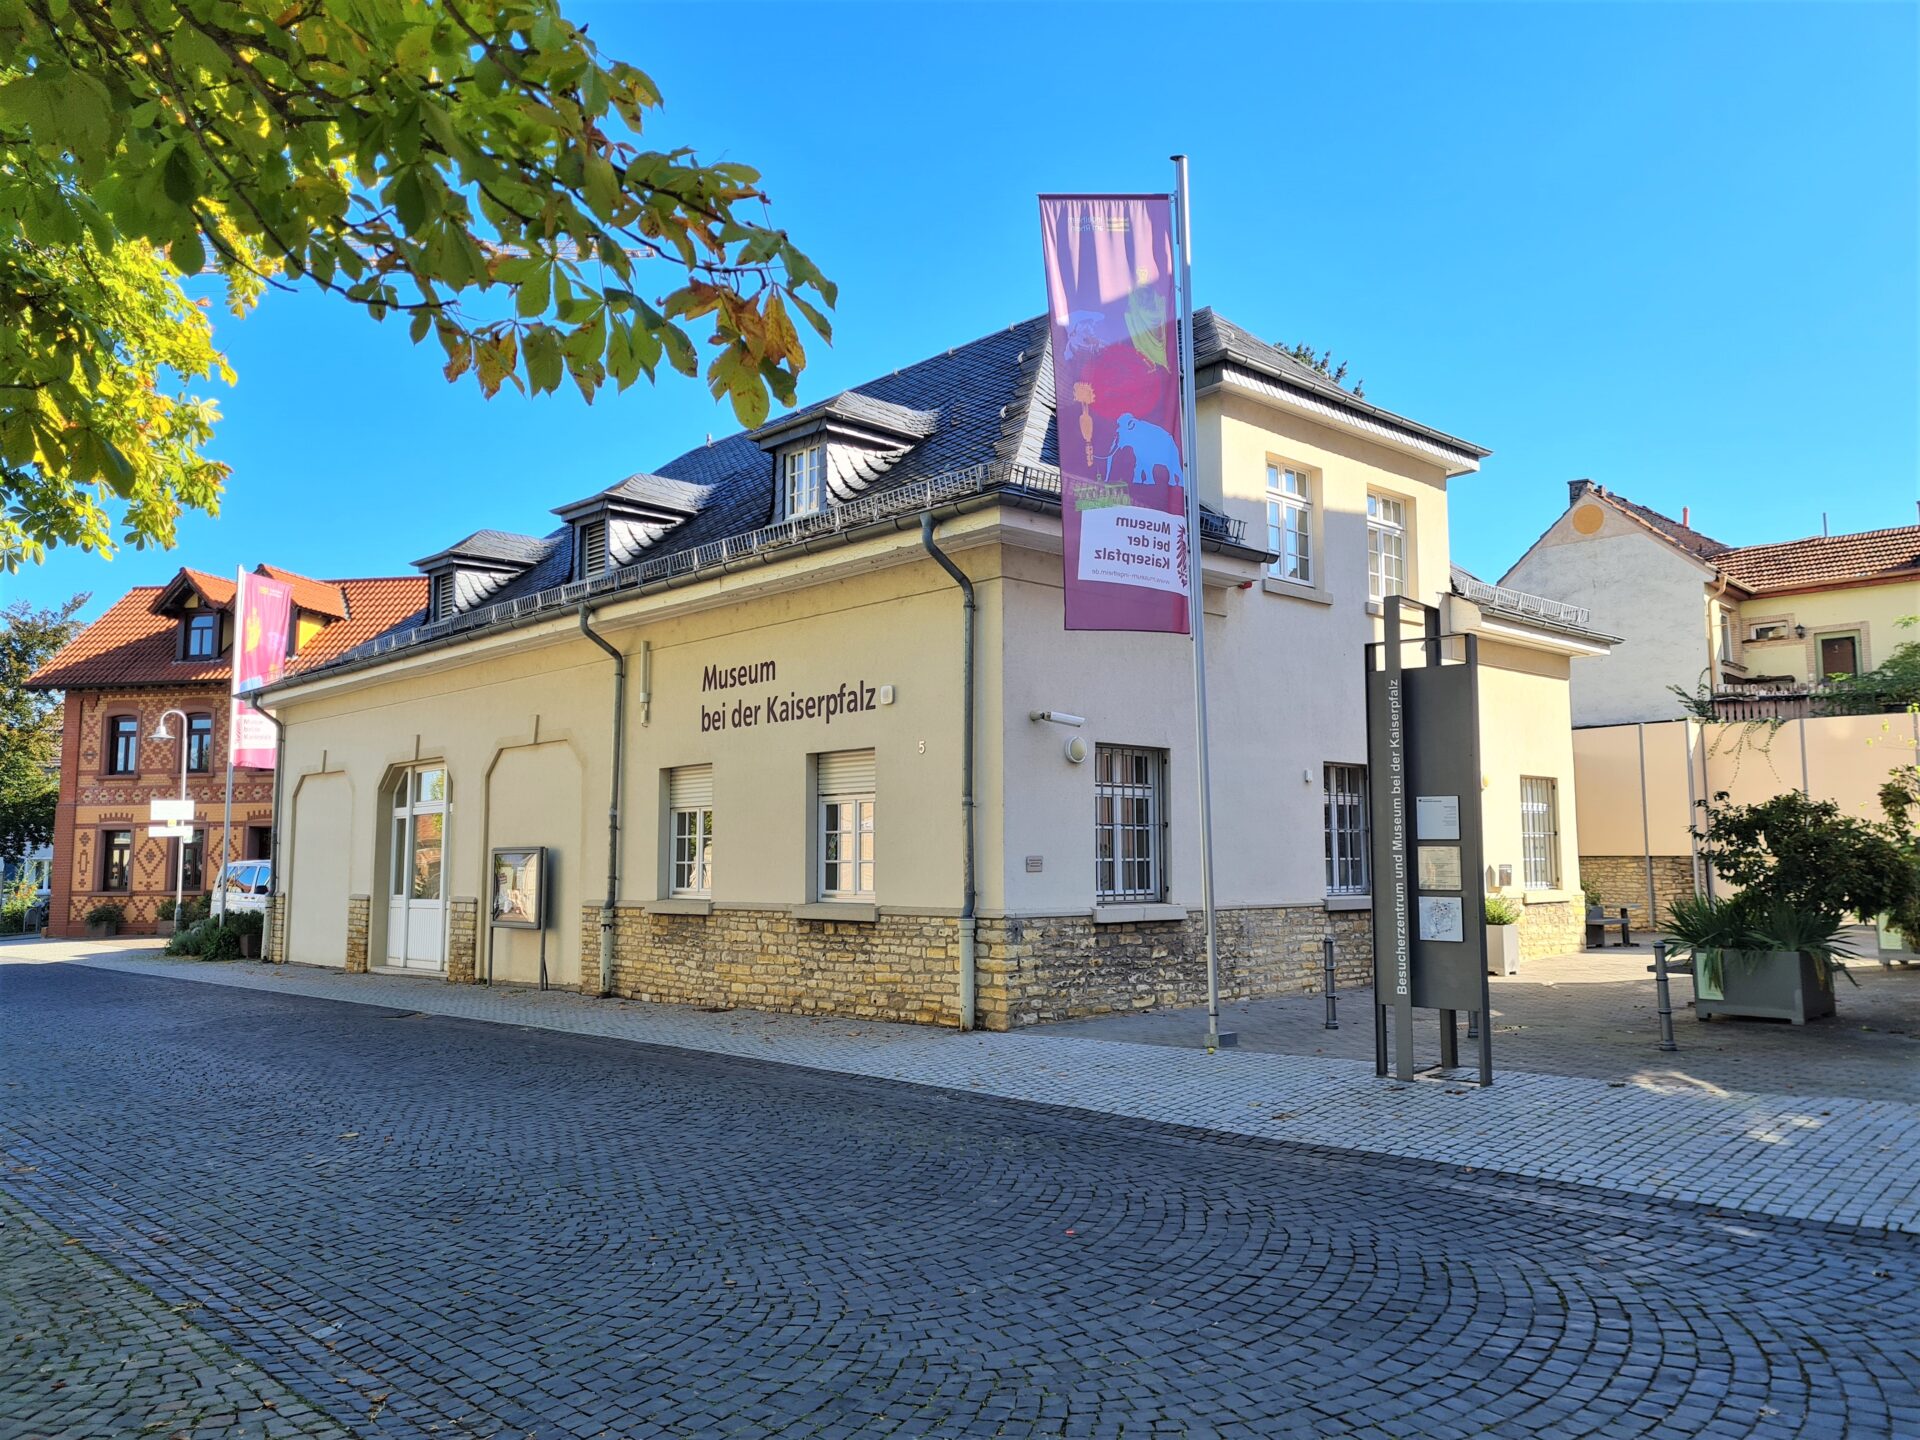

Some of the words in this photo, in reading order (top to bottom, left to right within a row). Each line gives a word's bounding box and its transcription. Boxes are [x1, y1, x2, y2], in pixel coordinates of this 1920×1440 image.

[702, 660, 776, 692] Museum
[701, 702, 726, 732] bei
[731, 699, 761, 728] der
[766, 680, 876, 724] Kaiserpfalz
[1388, 679, 1401, 748] Kaiserpfalz
[918, 740, 926, 754] 5
[1390, 752, 1400, 772] der
[1390, 775, 1401, 794] bei
[1392, 798, 1402, 850] Museum
[1392, 854, 1403, 878] und
[1395, 882, 1408, 995] Besucherzentrum
